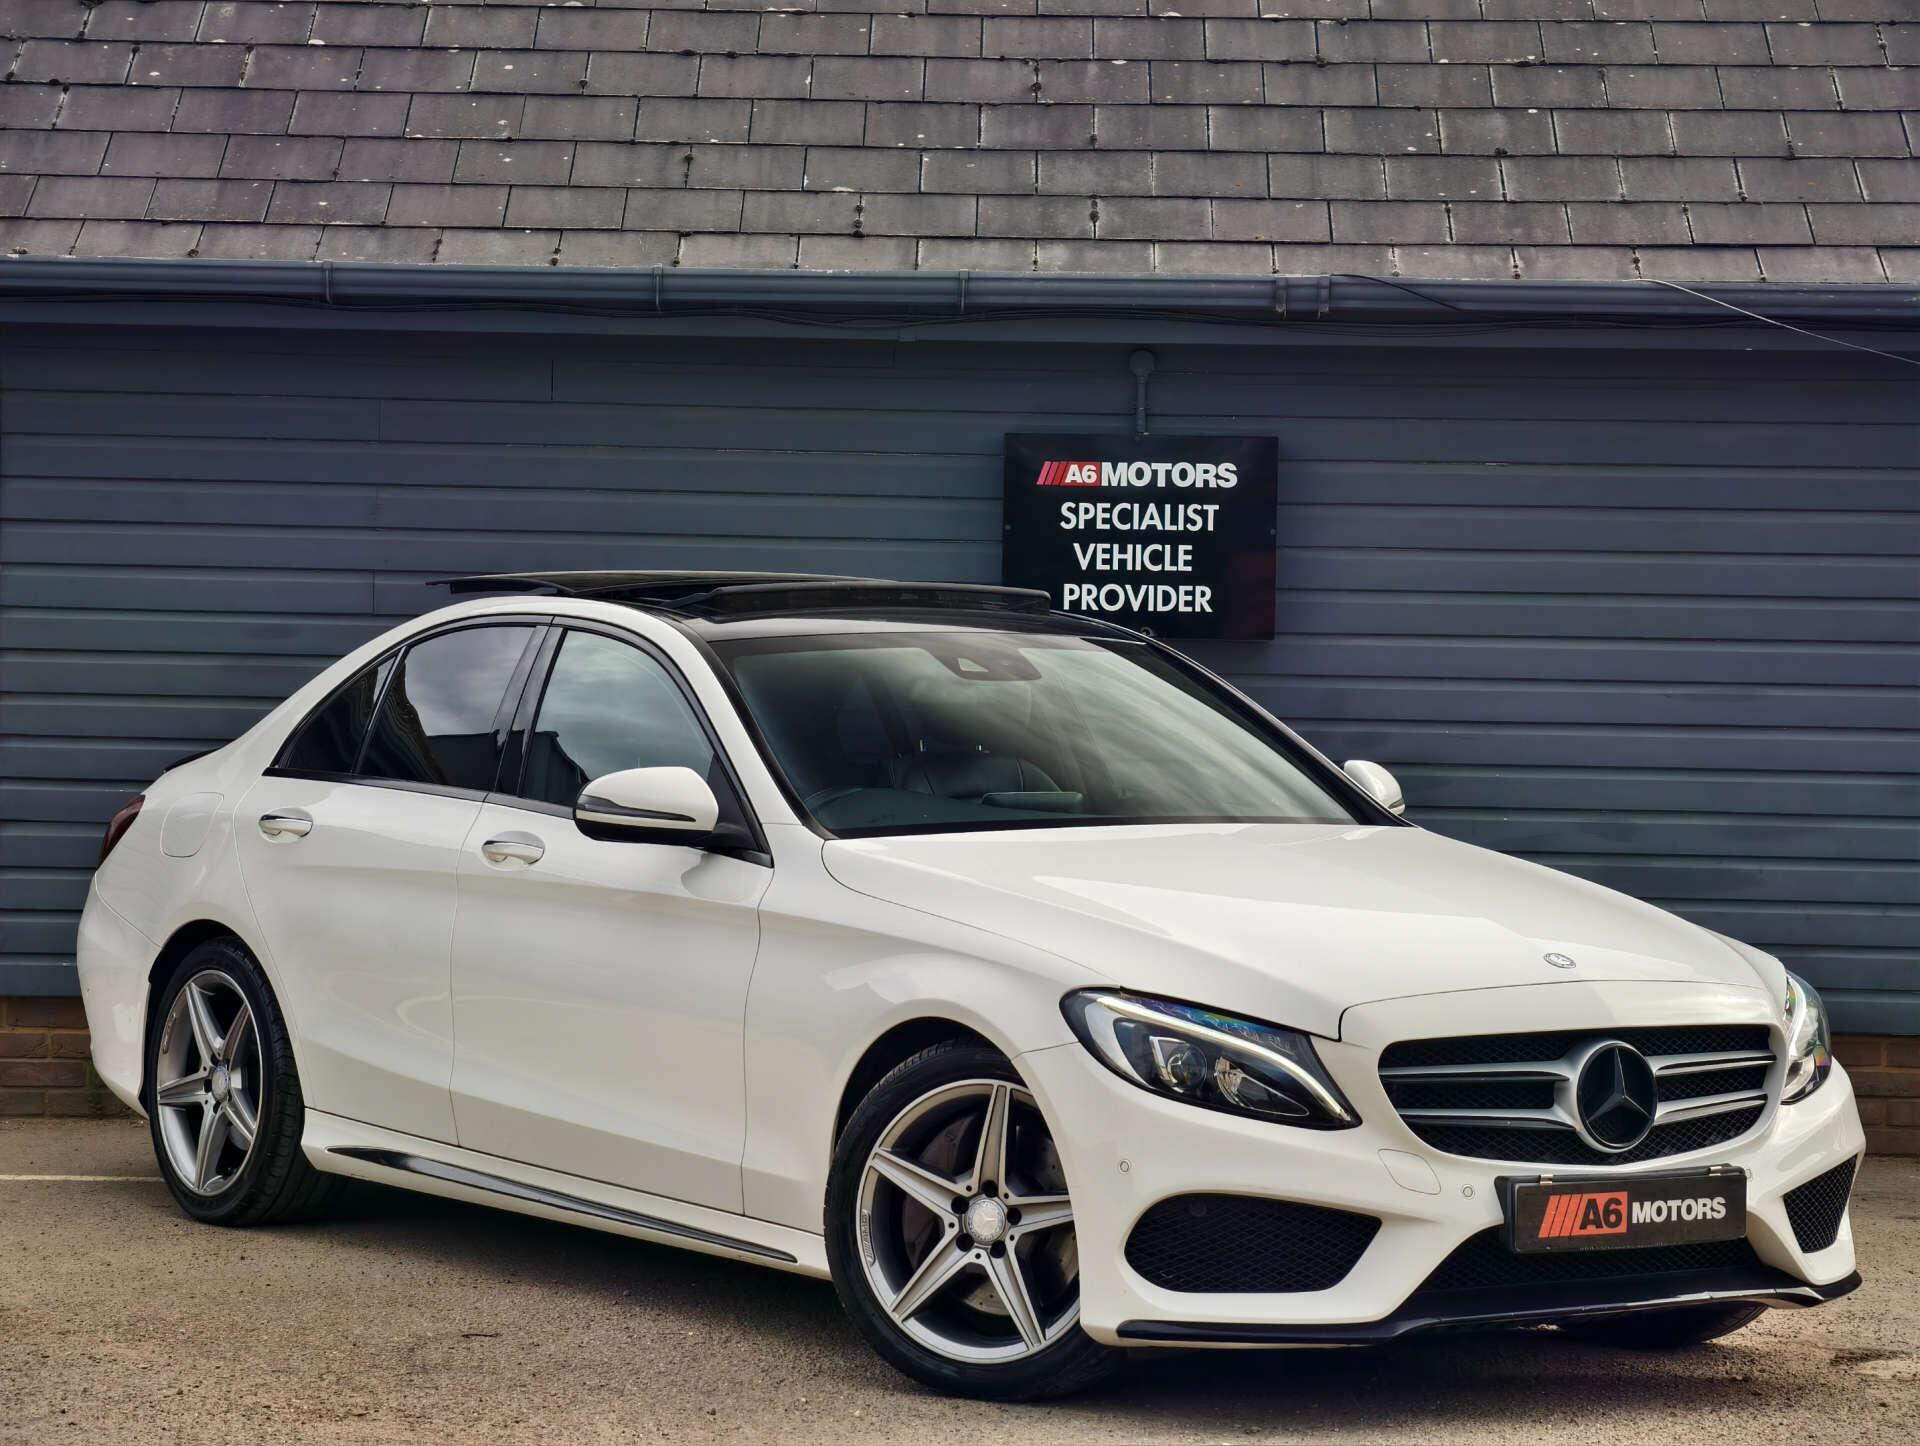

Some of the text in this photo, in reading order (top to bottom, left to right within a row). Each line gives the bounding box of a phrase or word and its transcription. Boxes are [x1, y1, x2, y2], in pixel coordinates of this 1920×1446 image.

[1065, 461, 1238, 488] A6 MOTORS
[1060, 502, 1220, 532] SPECIALIST
[1073, 543, 1193, 571] VEHICLE
[1063, 583, 1213, 613] PROVIDER
[1579, 1196, 1727, 1231] A6 MOTORS
